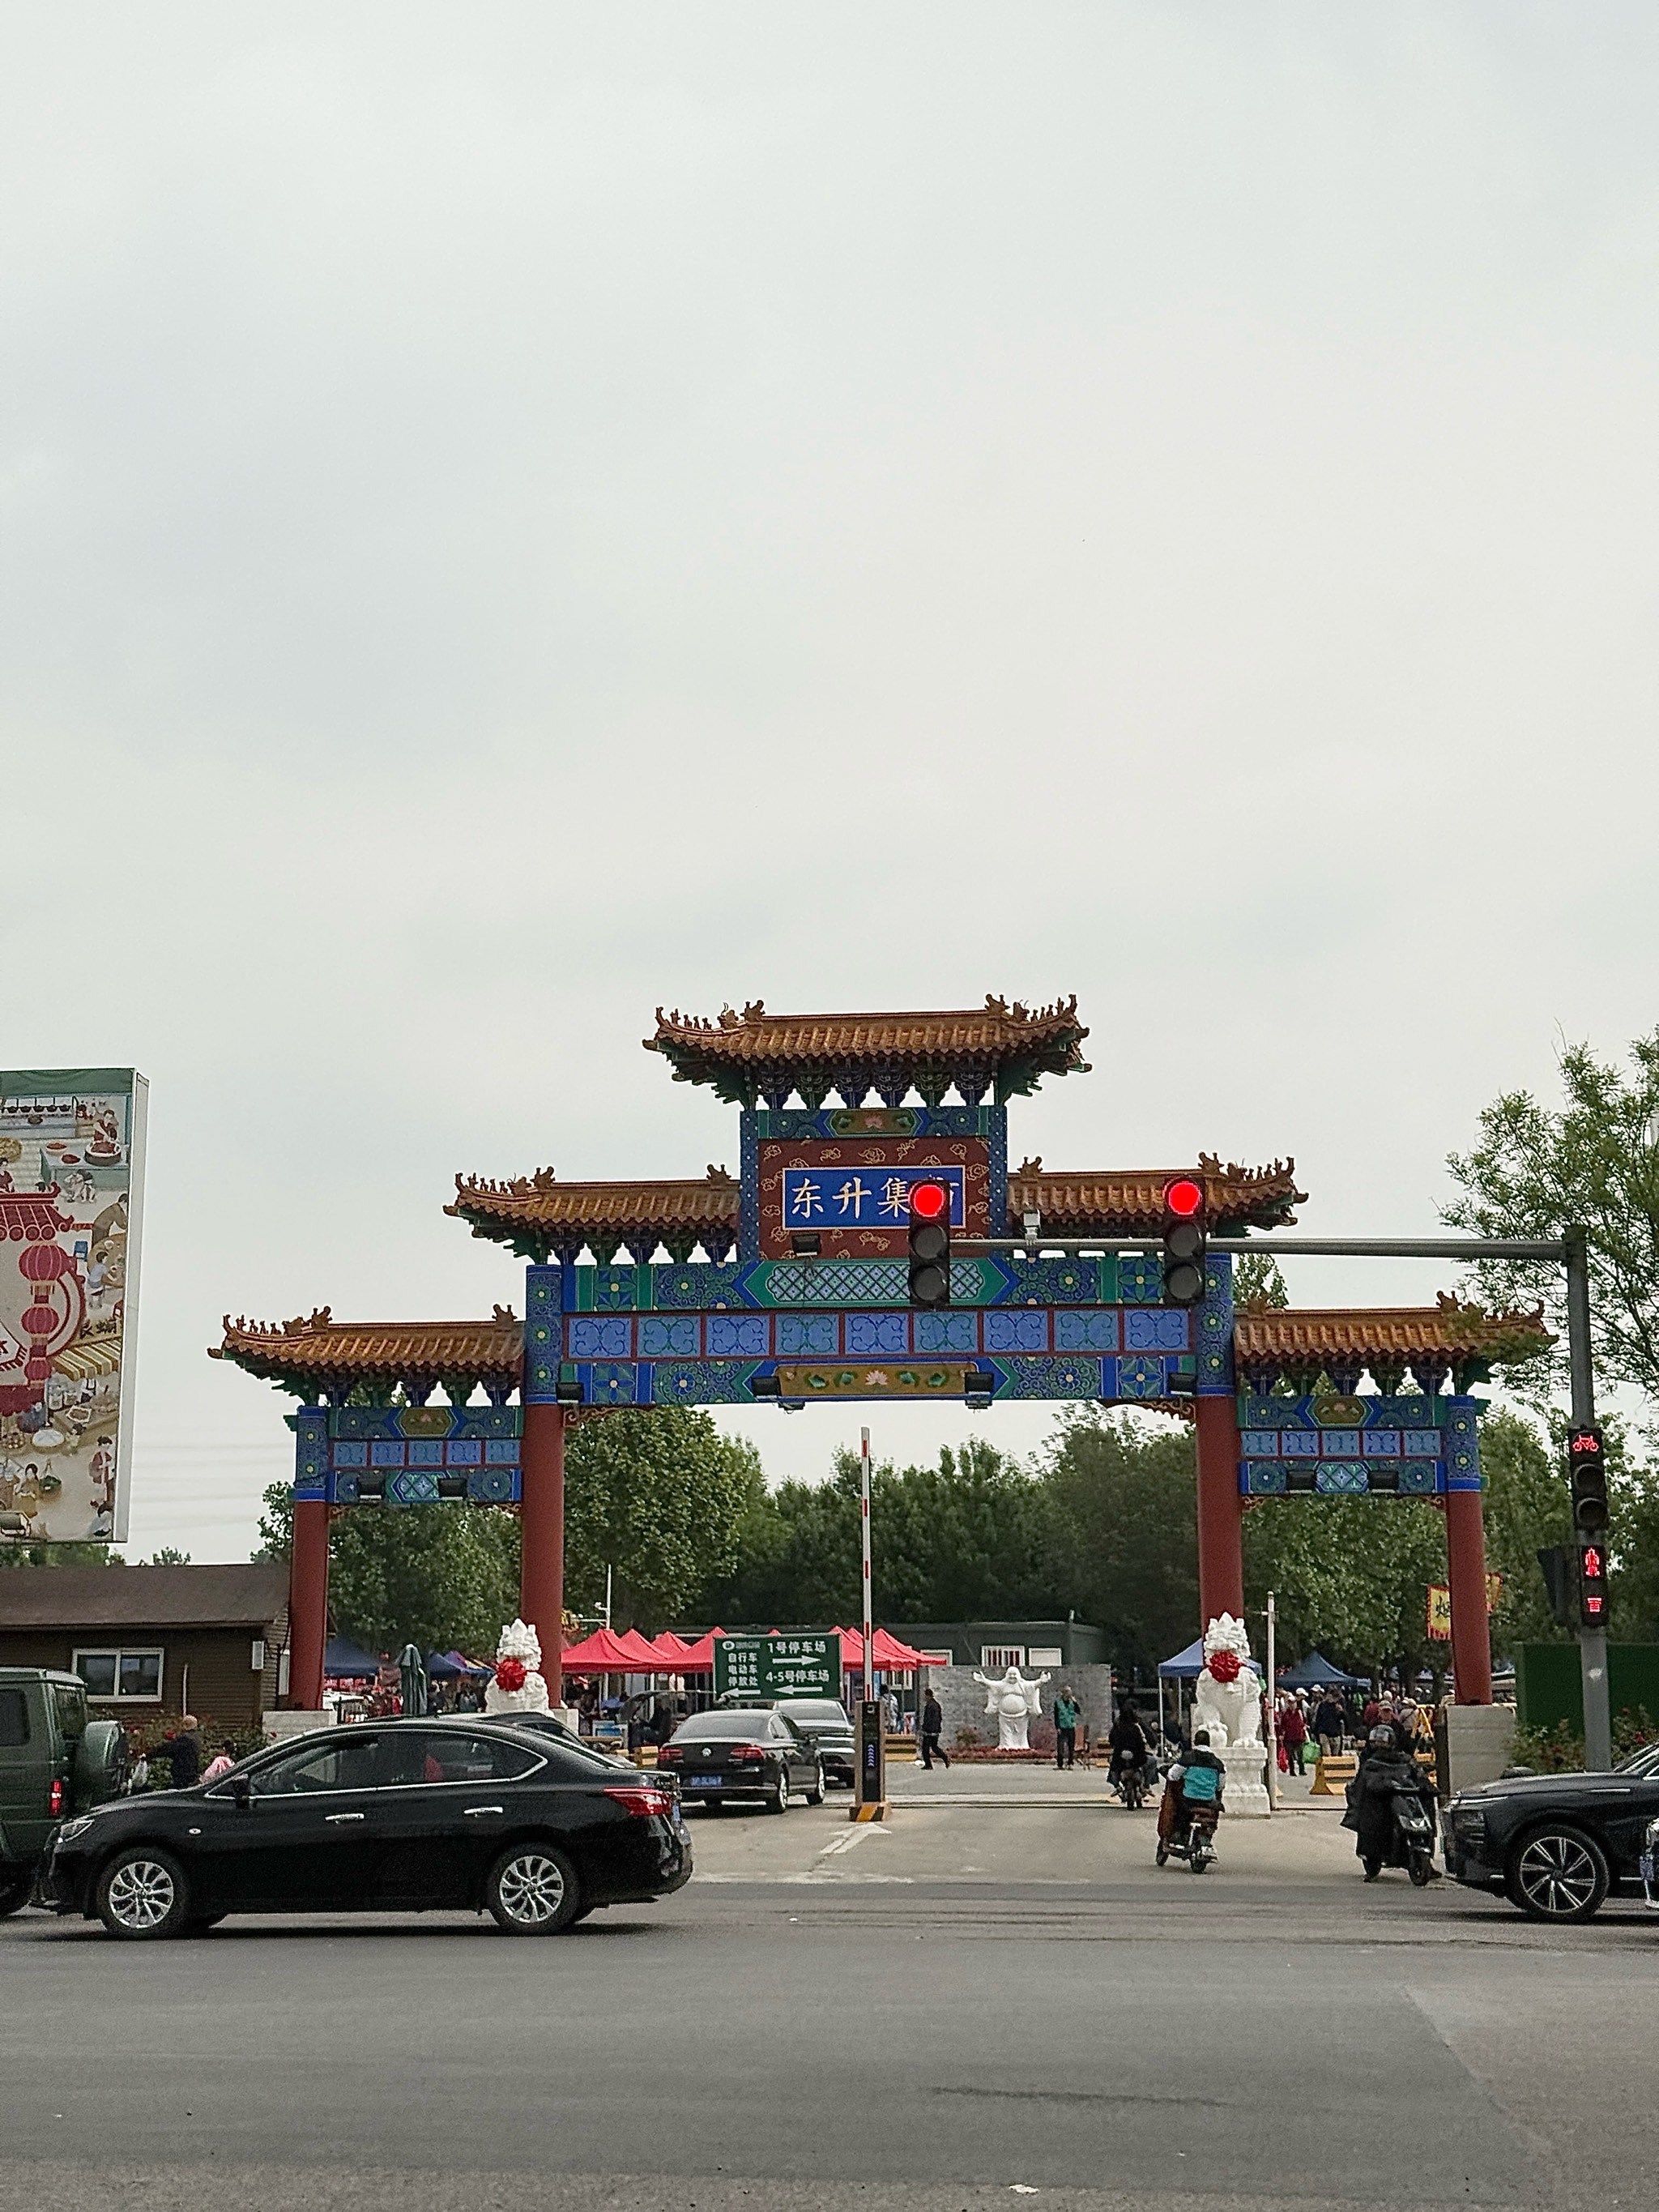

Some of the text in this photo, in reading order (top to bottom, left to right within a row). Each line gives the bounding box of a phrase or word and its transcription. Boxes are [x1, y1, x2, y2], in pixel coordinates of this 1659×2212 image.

[767, 1641, 826, 1654] 1号停车场
[728, 1652, 757, 1663] 自行车
[728, 1663, 758, 1675] 电动车
[728, 1676, 758, 1687] 停放处
[766, 1669, 830, 1683] 4-5号停车场
